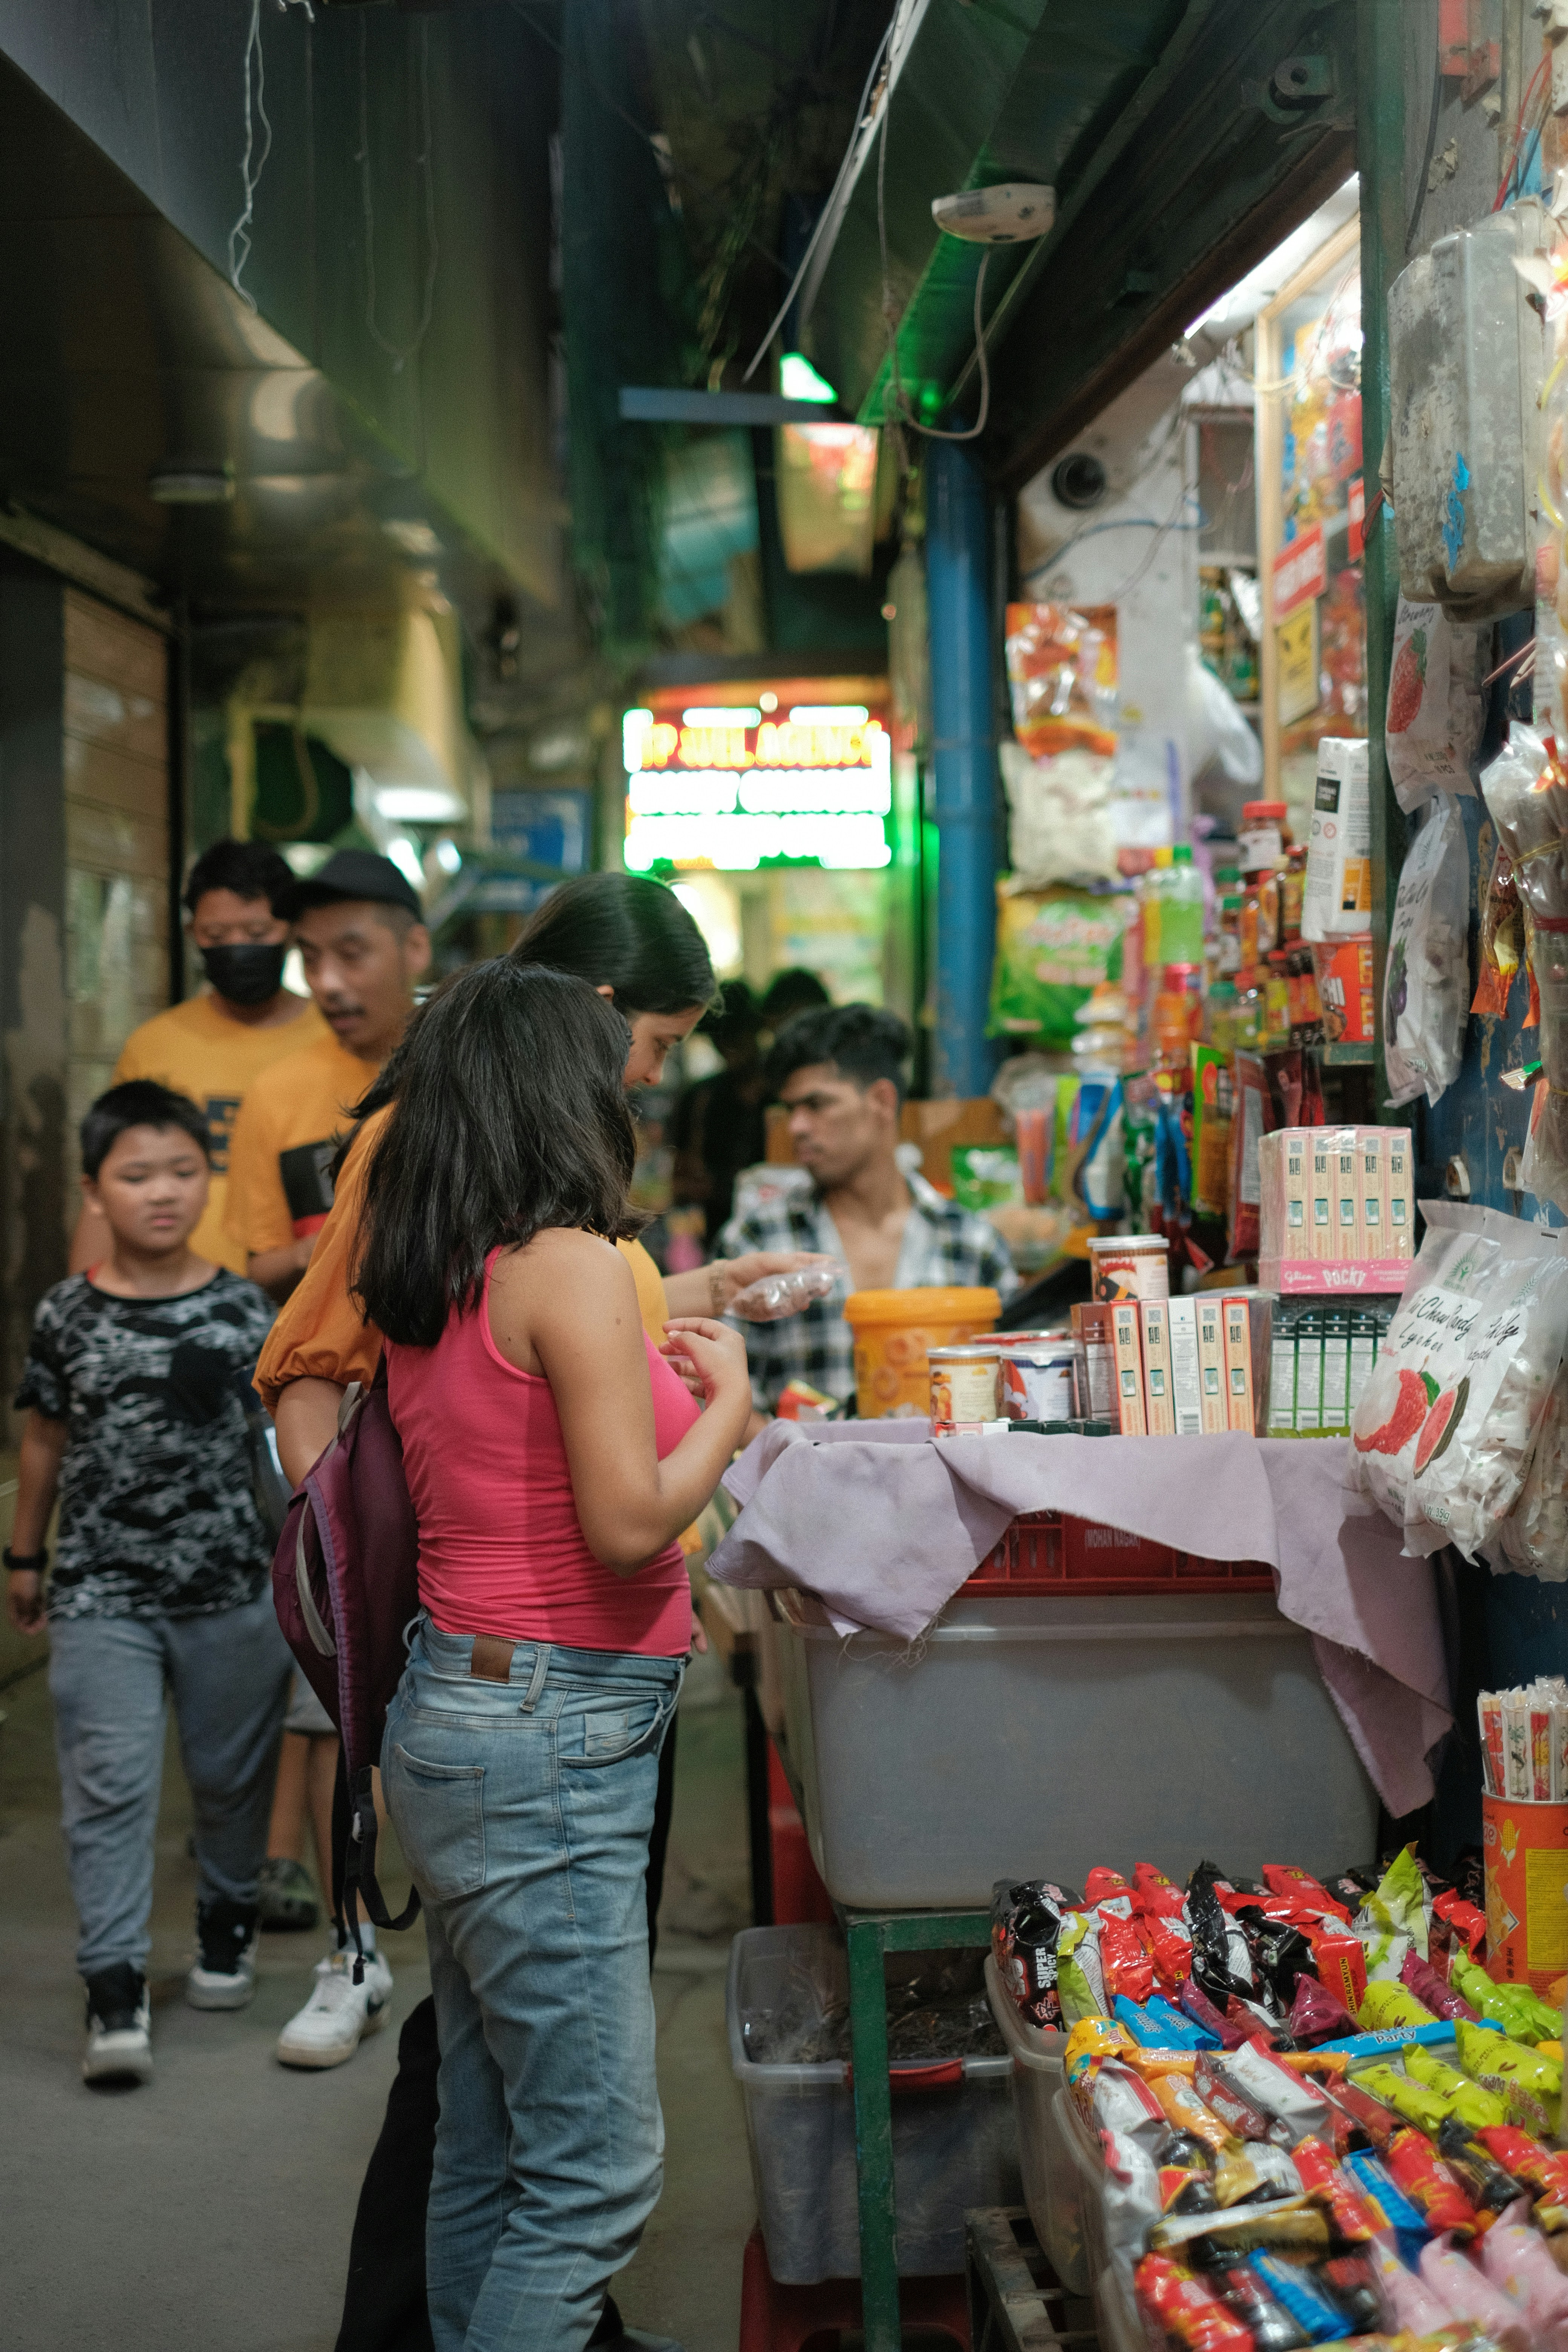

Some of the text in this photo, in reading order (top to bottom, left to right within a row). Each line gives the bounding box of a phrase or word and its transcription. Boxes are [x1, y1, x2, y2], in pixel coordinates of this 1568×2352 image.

[1416, 1297, 1449, 1324] Chew
[1406, 1926, 1415, 1947] SOON
[1035, 1947, 1051, 1989] SUPER
[1046, 1954, 1058, 1981] SPICY
[1340, 1957, 1357, 2015] SHIN RAMYUN
[1375, 2029, 1416, 2044] Party
